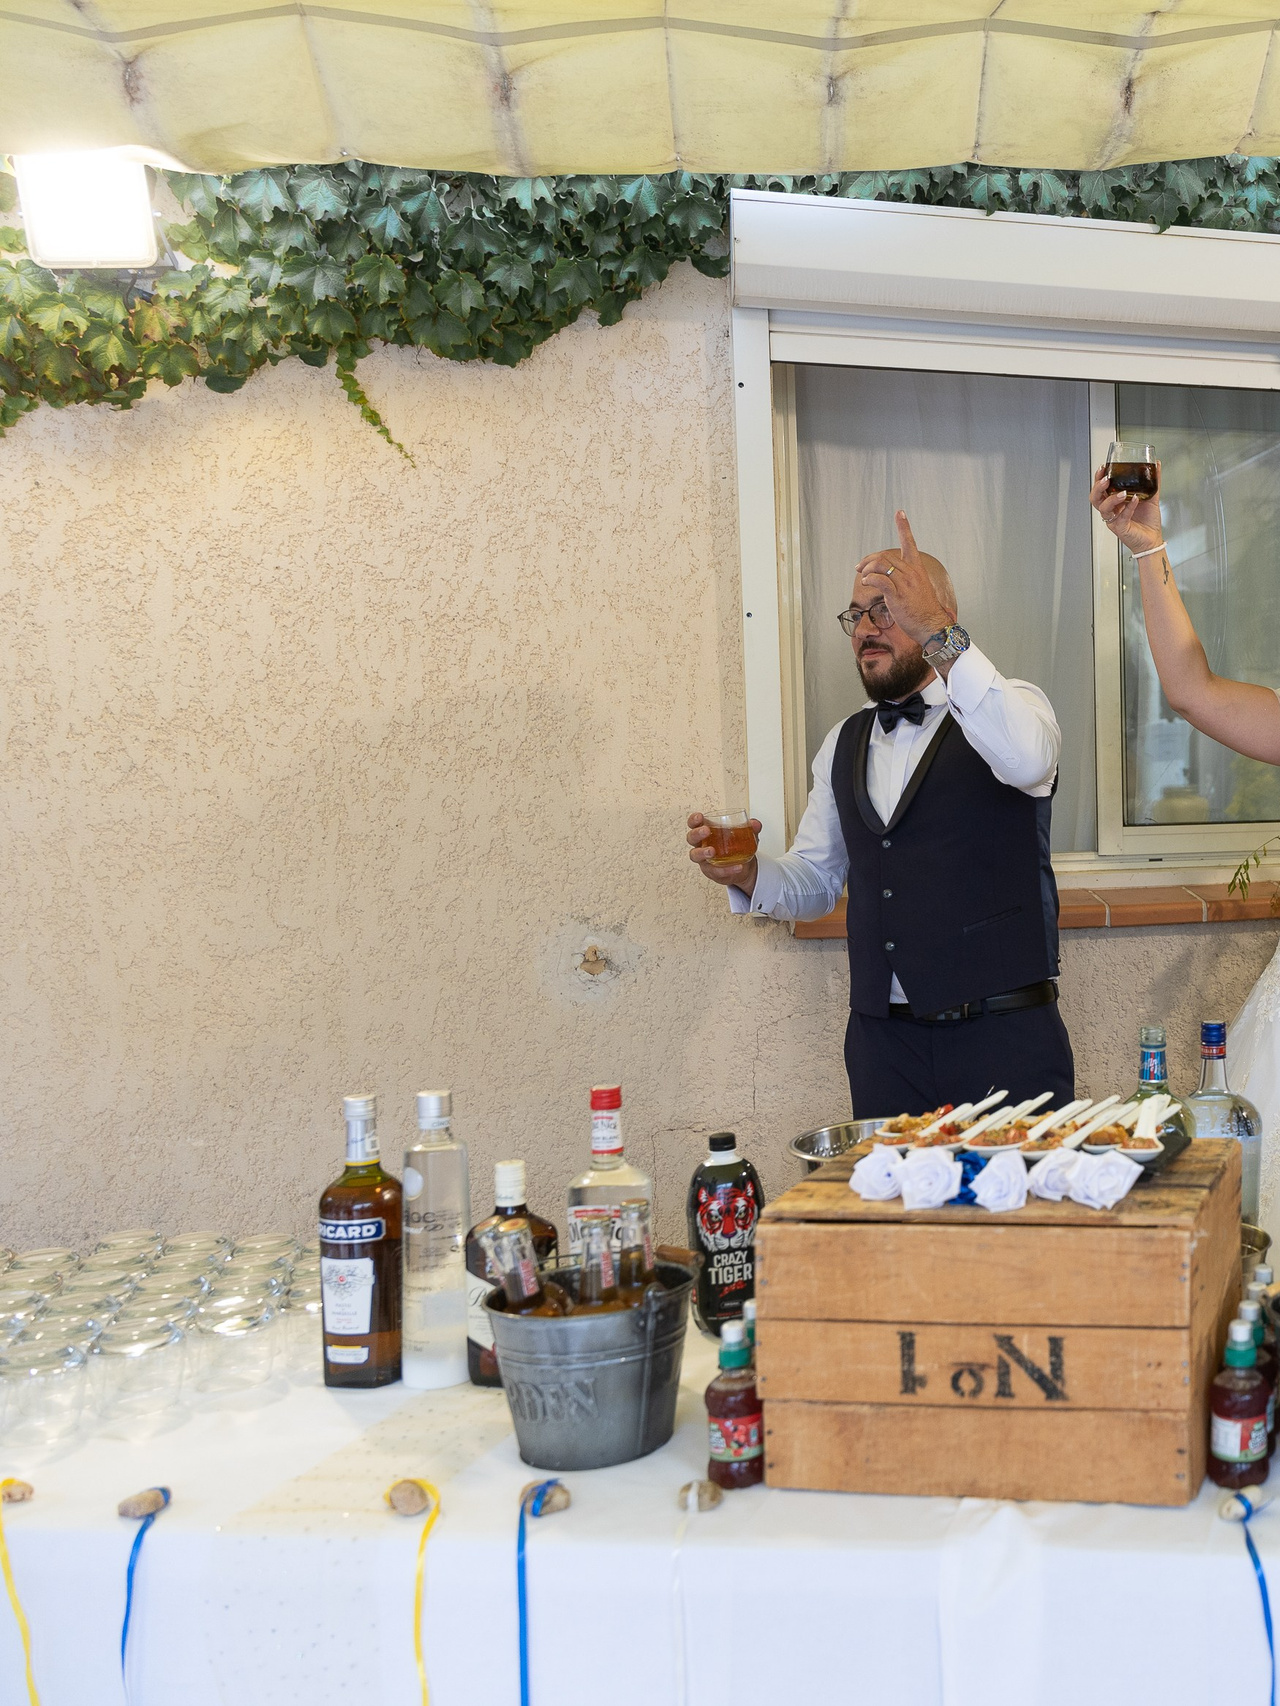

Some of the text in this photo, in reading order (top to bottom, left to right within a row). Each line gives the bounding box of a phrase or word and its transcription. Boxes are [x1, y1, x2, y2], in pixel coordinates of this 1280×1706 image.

[317, 1223, 377, 1239] RICARD
[713, 1250, 748, 1268] CRAZY
[707, 1263, 753, 1285] TIGER
